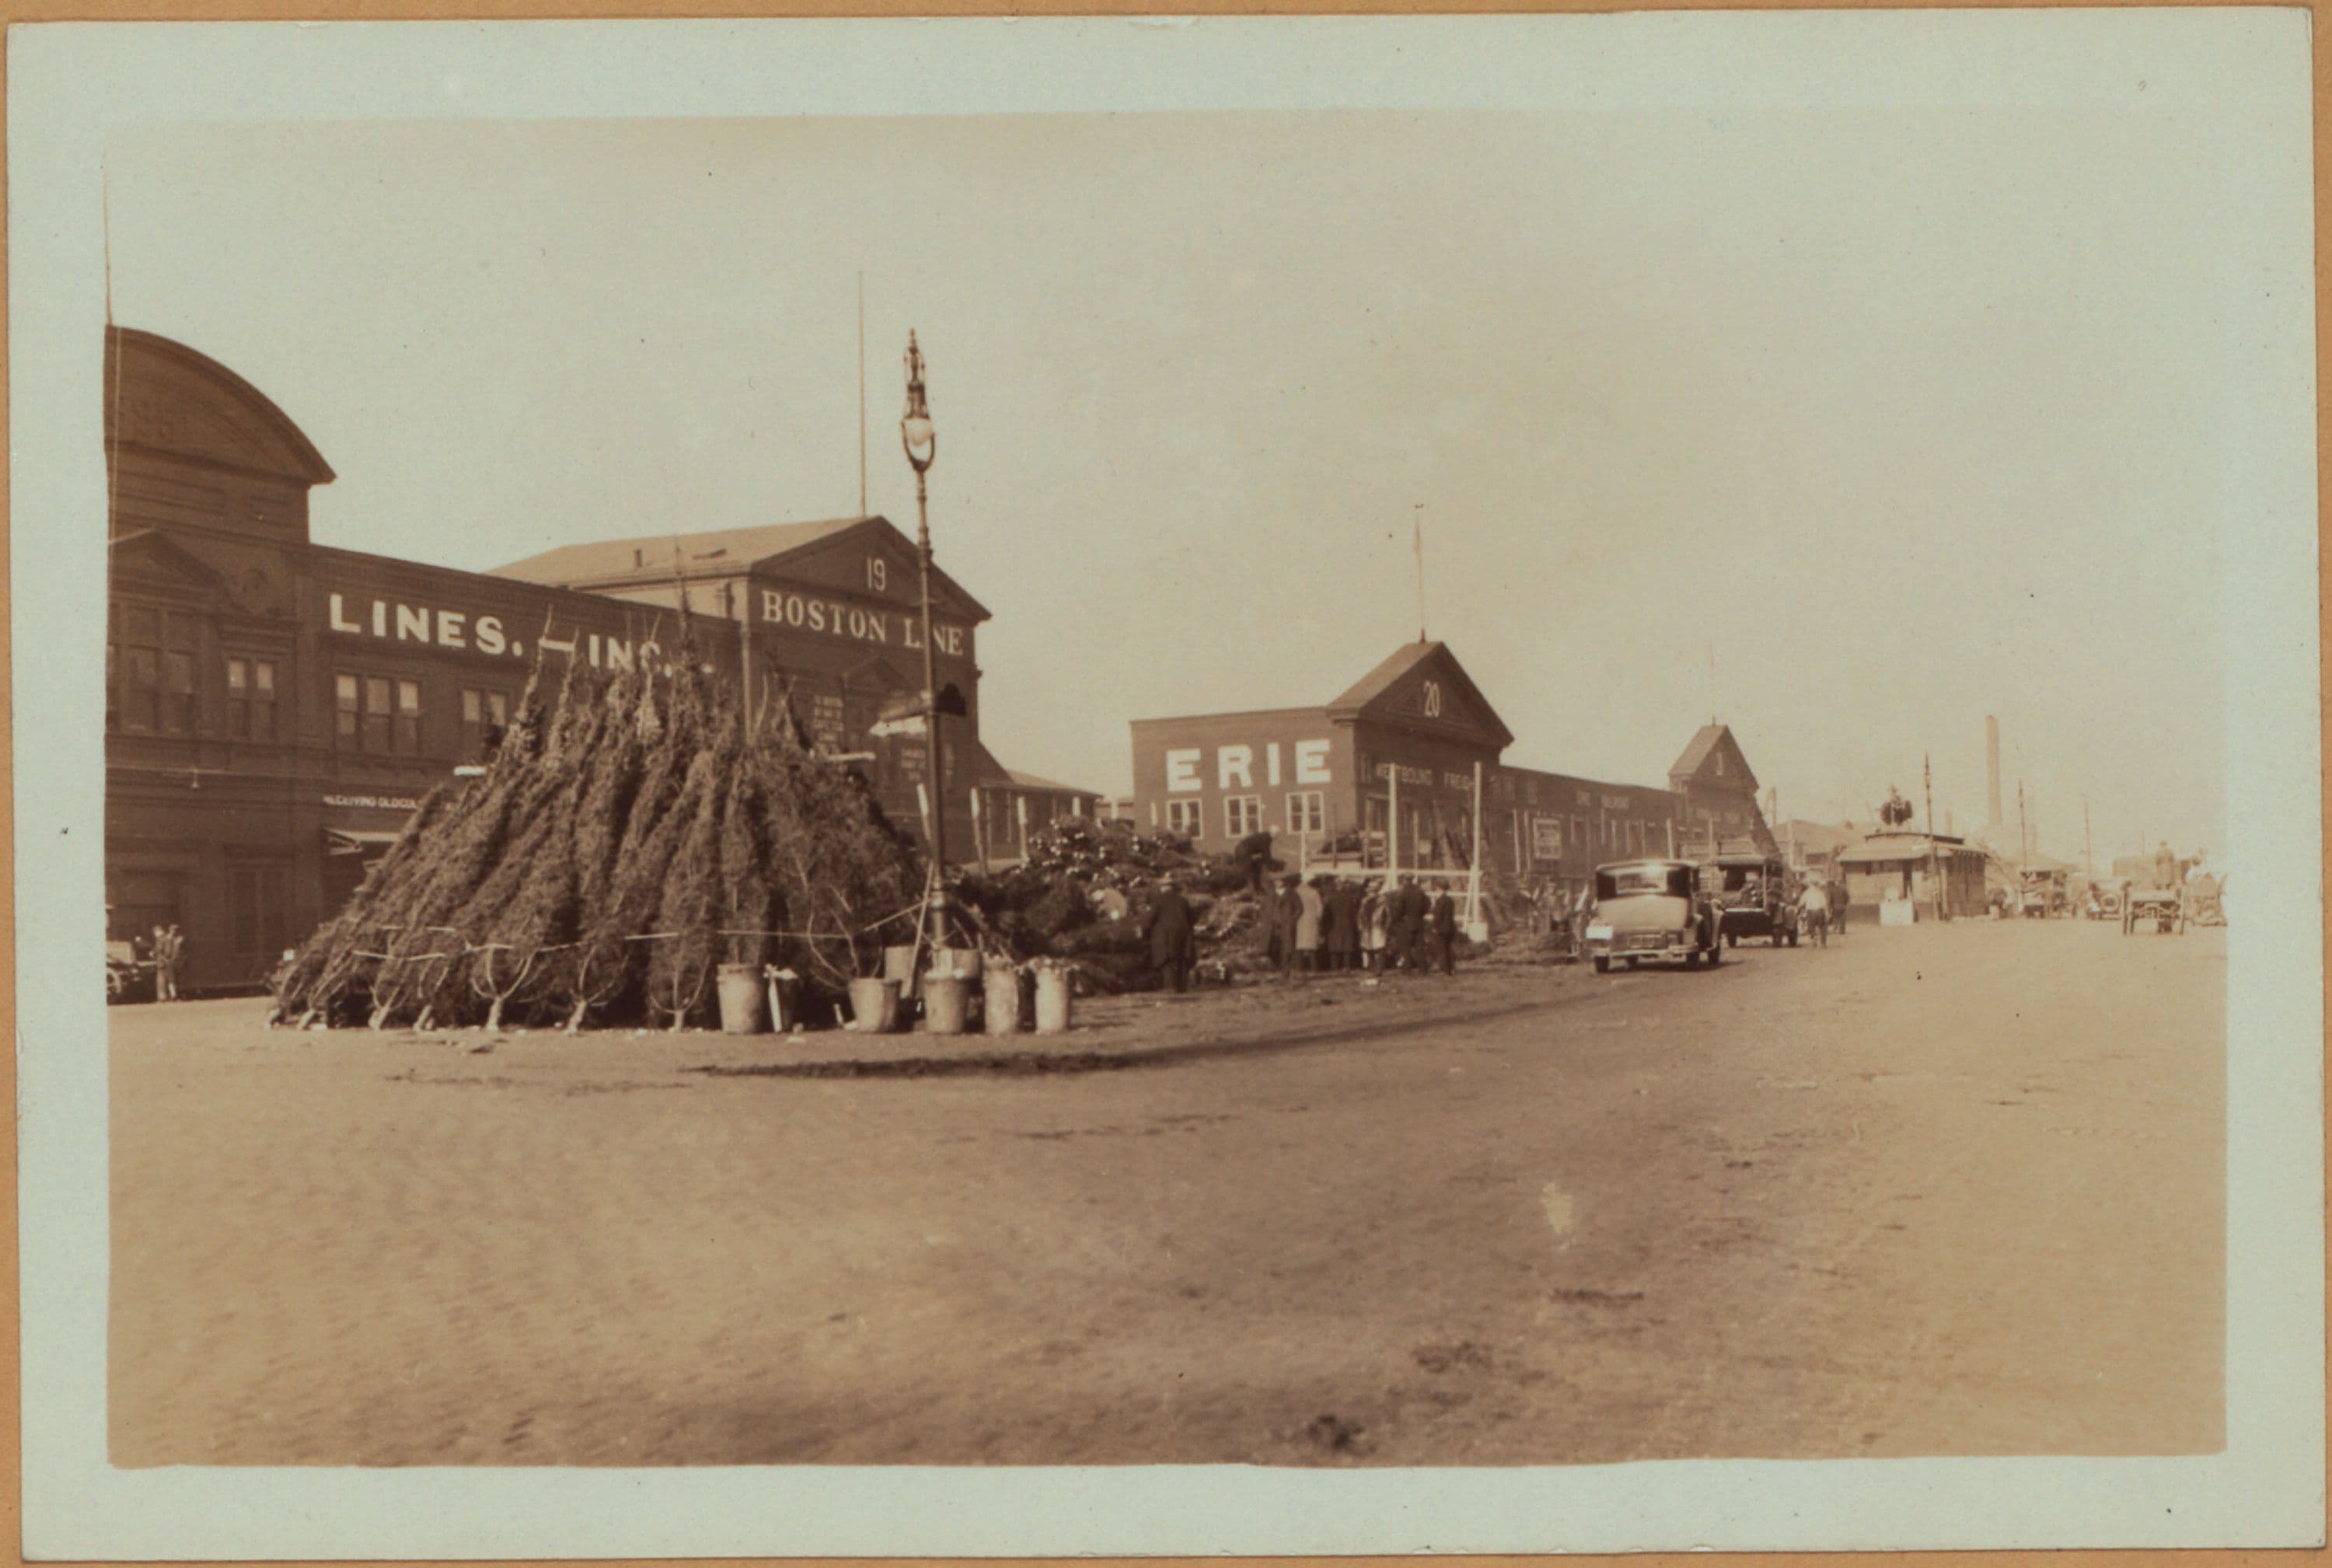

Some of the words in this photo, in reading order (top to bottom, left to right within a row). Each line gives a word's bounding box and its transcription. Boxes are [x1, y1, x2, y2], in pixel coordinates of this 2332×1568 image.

[867, 557, 887, 591] 19
[330, 593, 523, 656] LINES.
[762, 590, 887, 643] BOSTON
[903, 618, 964, 656] LNE
[1423, 680, 1440, 718] 20
[1166, 739, 1332, 792] ERIE
[1377, 763, 1433, 787] WETBOUND
